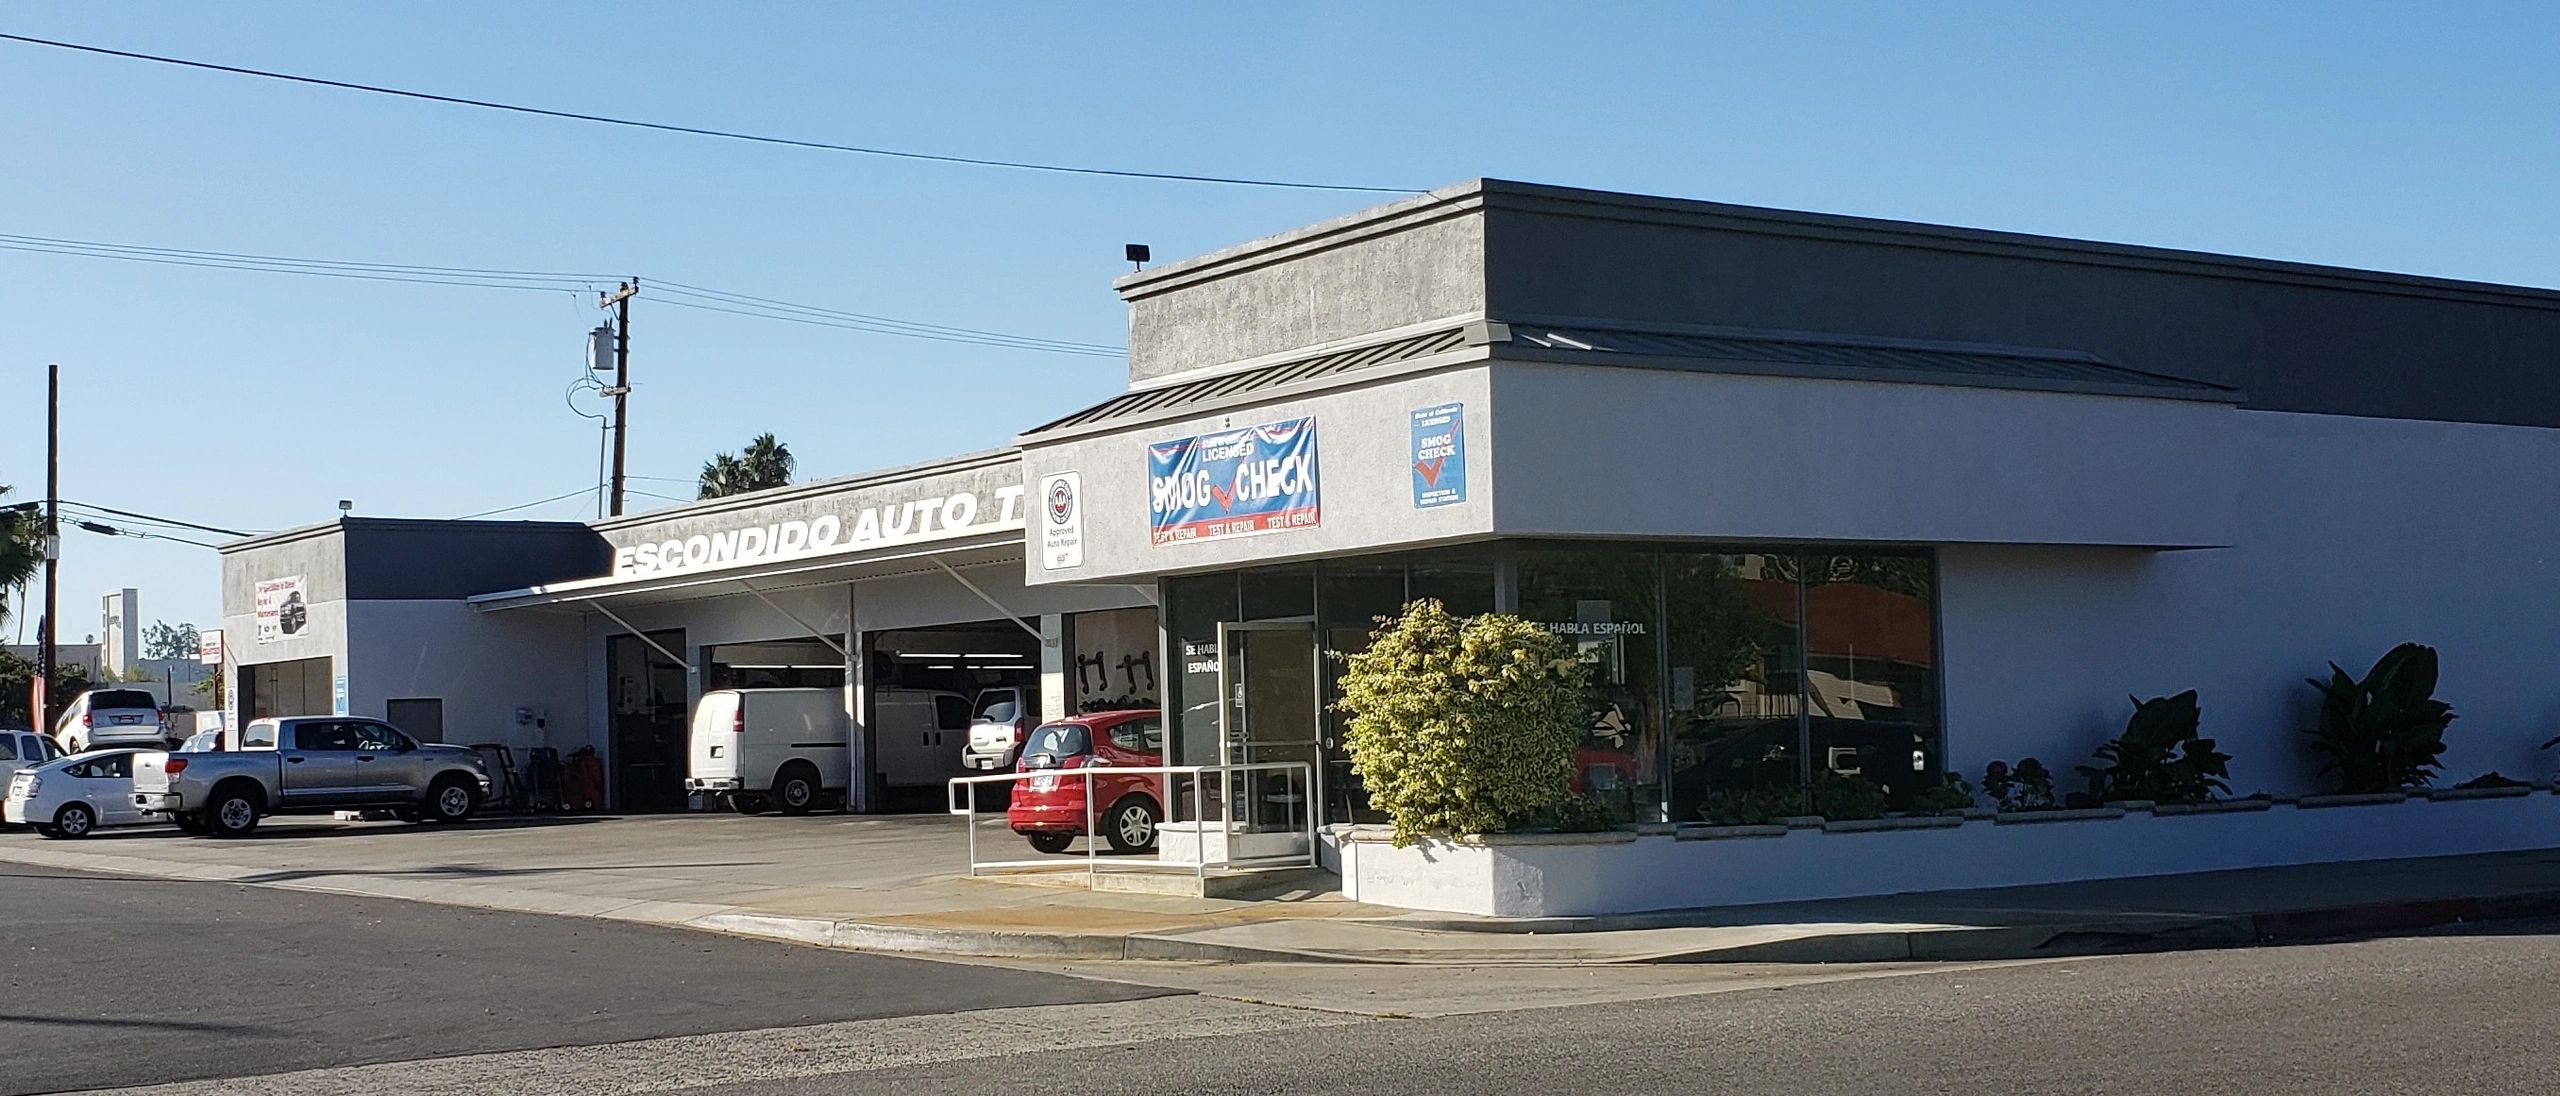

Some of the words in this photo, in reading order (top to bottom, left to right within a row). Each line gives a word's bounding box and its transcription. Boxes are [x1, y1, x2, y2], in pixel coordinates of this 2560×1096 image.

[1421, 434, 1452, 449] SMOG
[1202, 443, 1255, 463] LICENSED
[1418, 445, 1456, 460] CHECK
[1152, 469, 1211, 513] SMOG
[1236, 454, 1313, 501] CHECK
[1267, 516, 1284, 528] TEST
[1285, 515, 1291, 528] &
[1292, 512, 1317, 527] REPAIR
[613, 515, 841, 575] ESCONDIDO
[849, 492, 978, 545] AUTO
[995, 485, 1025, 524] T
[1049, 526, 1074, 537] Approved
[1175, 527, 1197, 541] REPAIR
[1208, 524, 1226, 536] TEST
[1226, 523, 1231, 534] &
[1232, 520, 1255, 533] REPAIR
[1047, 540, 1060, 548] Auto
[1060, 538, 1077, 548] Repair
[1549, 622, 1590, 634] HABLA
[1593, 621, 1647, 634] ESPAÑOL
[1185, 644, 1197, 656] SE
[1197, 643, 1218, 655] HABL
[1188, 659, 1220, 674] ESPAÑO
